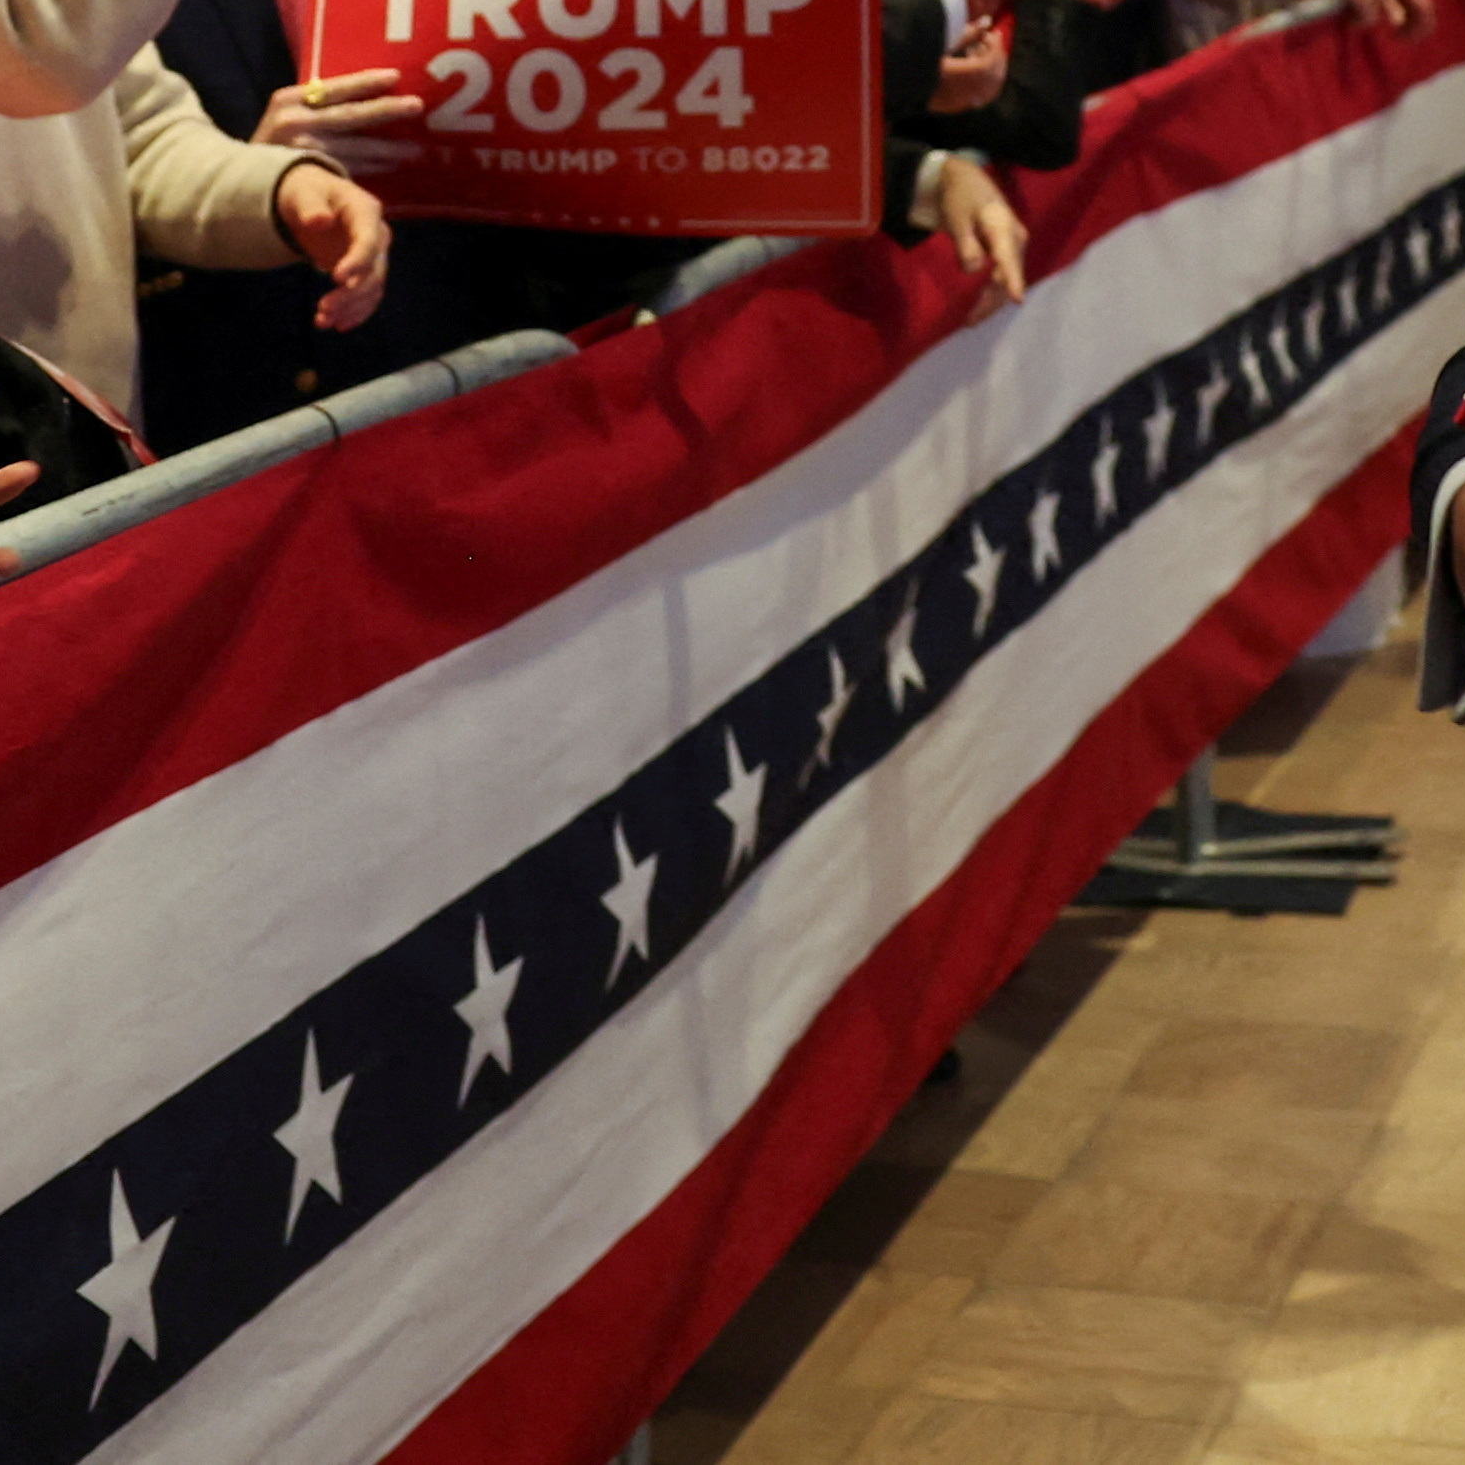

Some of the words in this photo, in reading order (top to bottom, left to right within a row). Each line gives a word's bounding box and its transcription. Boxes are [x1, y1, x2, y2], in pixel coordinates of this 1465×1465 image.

[427, 47, 753, 131] 2024
[474, 146, 619, 174] TRUMP
[632, 145, 690, 172] TO
[701, 144, 832, 172] 88022
